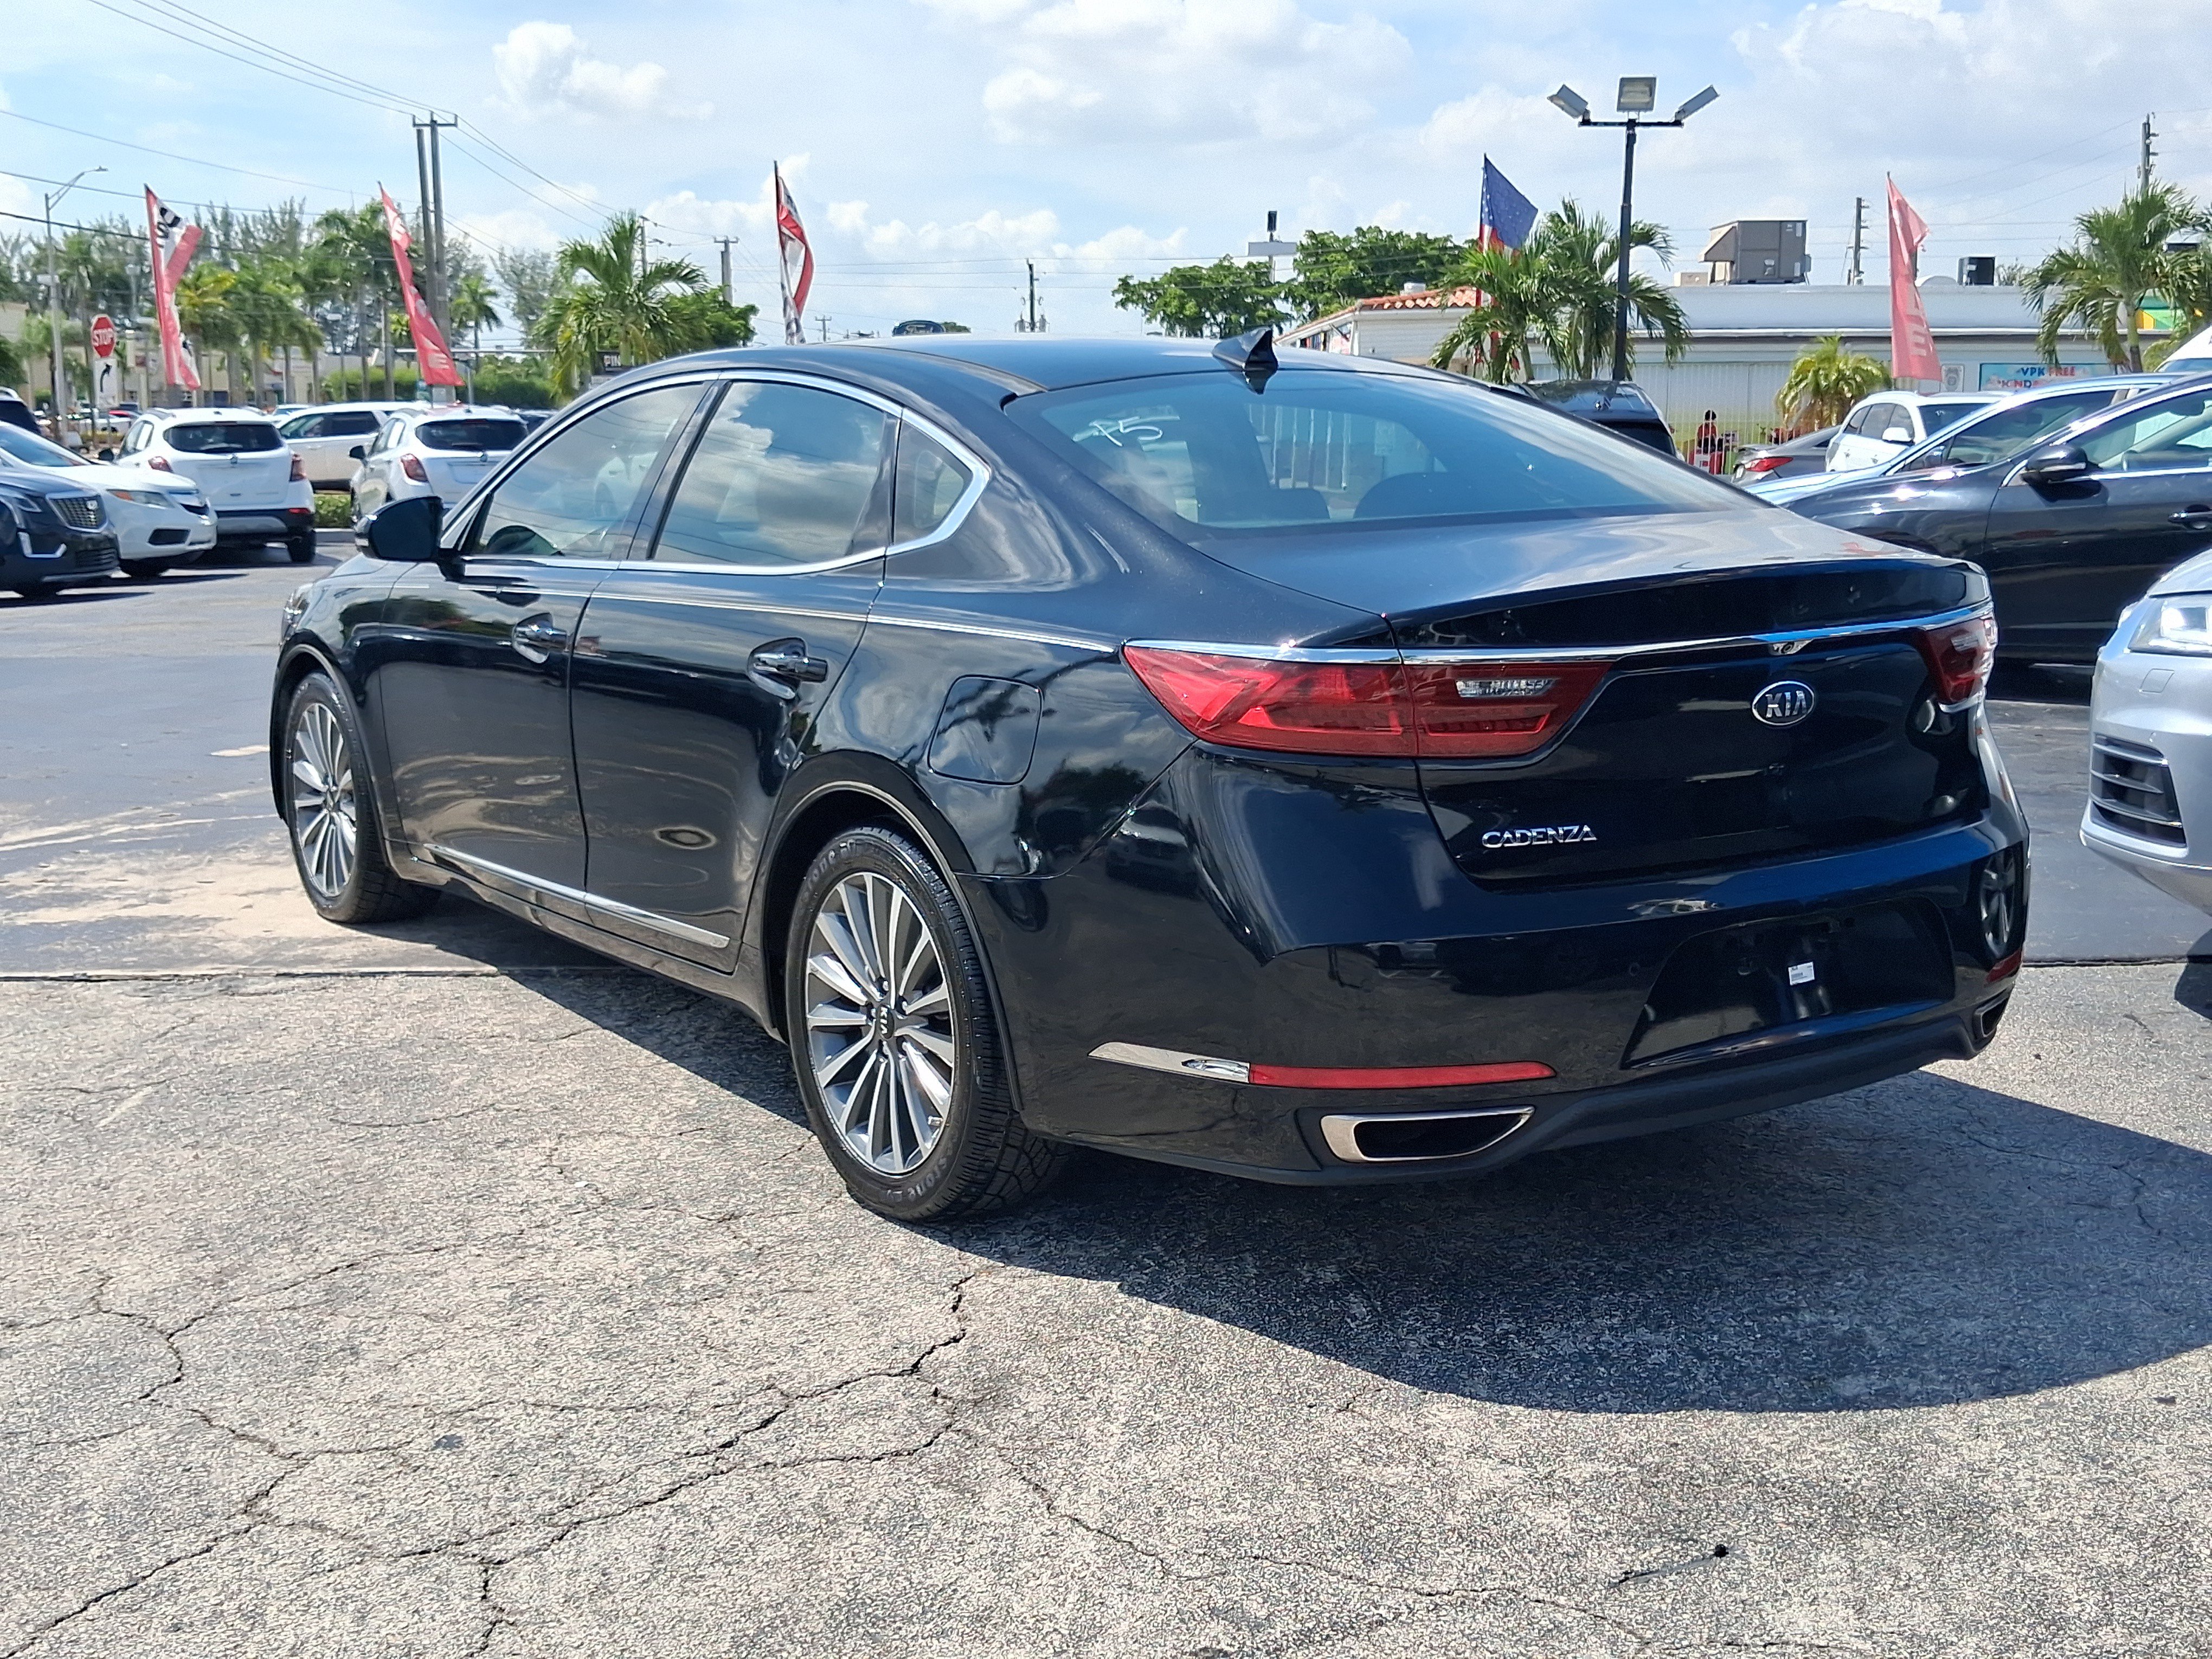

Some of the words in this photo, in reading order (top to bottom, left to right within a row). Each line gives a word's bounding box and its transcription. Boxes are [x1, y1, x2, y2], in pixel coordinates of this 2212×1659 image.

[92, 328, 115, 347] STOP
[2021, 366, 2046, 376] VPK
[1765, 690, 1808, 718] KIA
[1482, 825, 1597, 848] CADENZA
